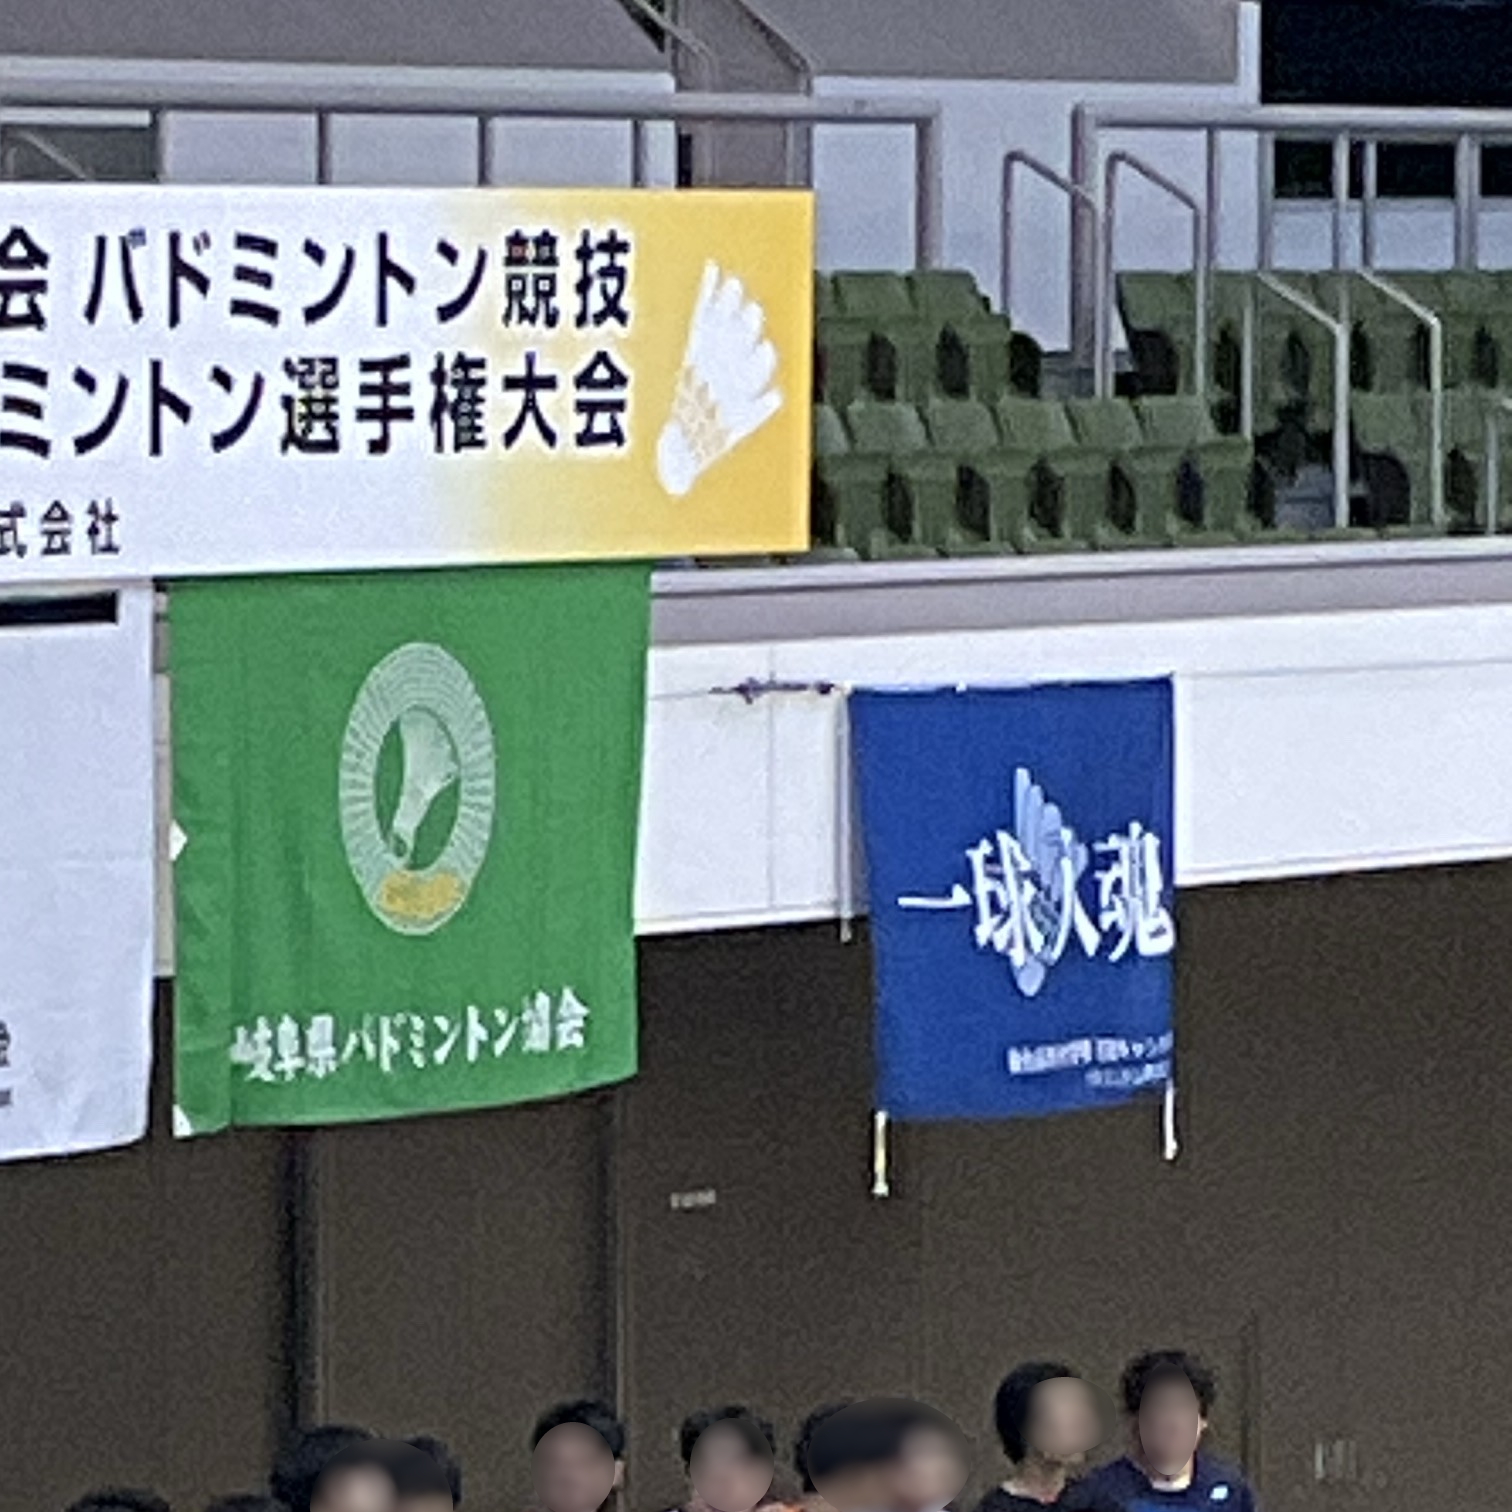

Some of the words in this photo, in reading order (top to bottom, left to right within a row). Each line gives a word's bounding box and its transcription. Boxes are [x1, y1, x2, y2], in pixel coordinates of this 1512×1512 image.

[84, 230, 629, 328] バドミントン競技
